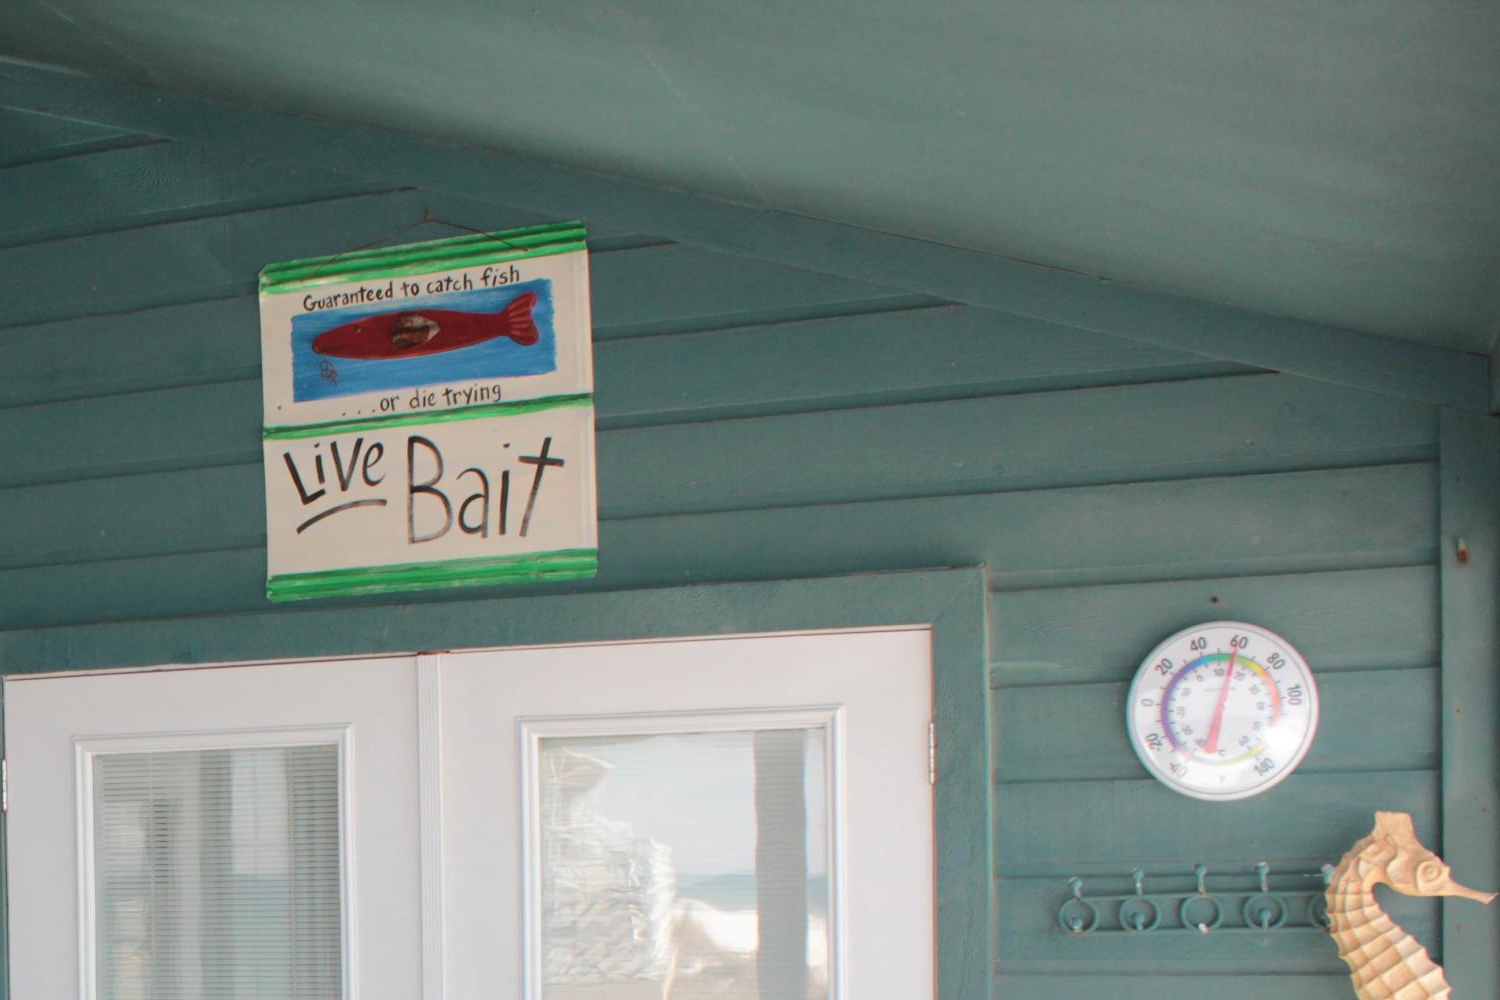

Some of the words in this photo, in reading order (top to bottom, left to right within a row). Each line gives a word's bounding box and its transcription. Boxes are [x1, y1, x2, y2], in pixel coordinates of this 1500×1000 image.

[303, 281, 393, 312] Guaranteed
[402, 281, 420, 297] to
[426, 273, 473, 295] catch
[480, 265, 520, 288] fish
[409, 388, 436, 409] die
[442, 383, 502, 406] trying
[407, 435, 565, 545] Bait
[1189, 636, 1208, 652] 40
[1230, 634, 1249, 650] 60
[1154, 658, 1173, 676] 20
[1266, 652, 1286, 671] 80
[1286, 684, 1303, 706] 100
[1253, 757, 1275, 777] 140
